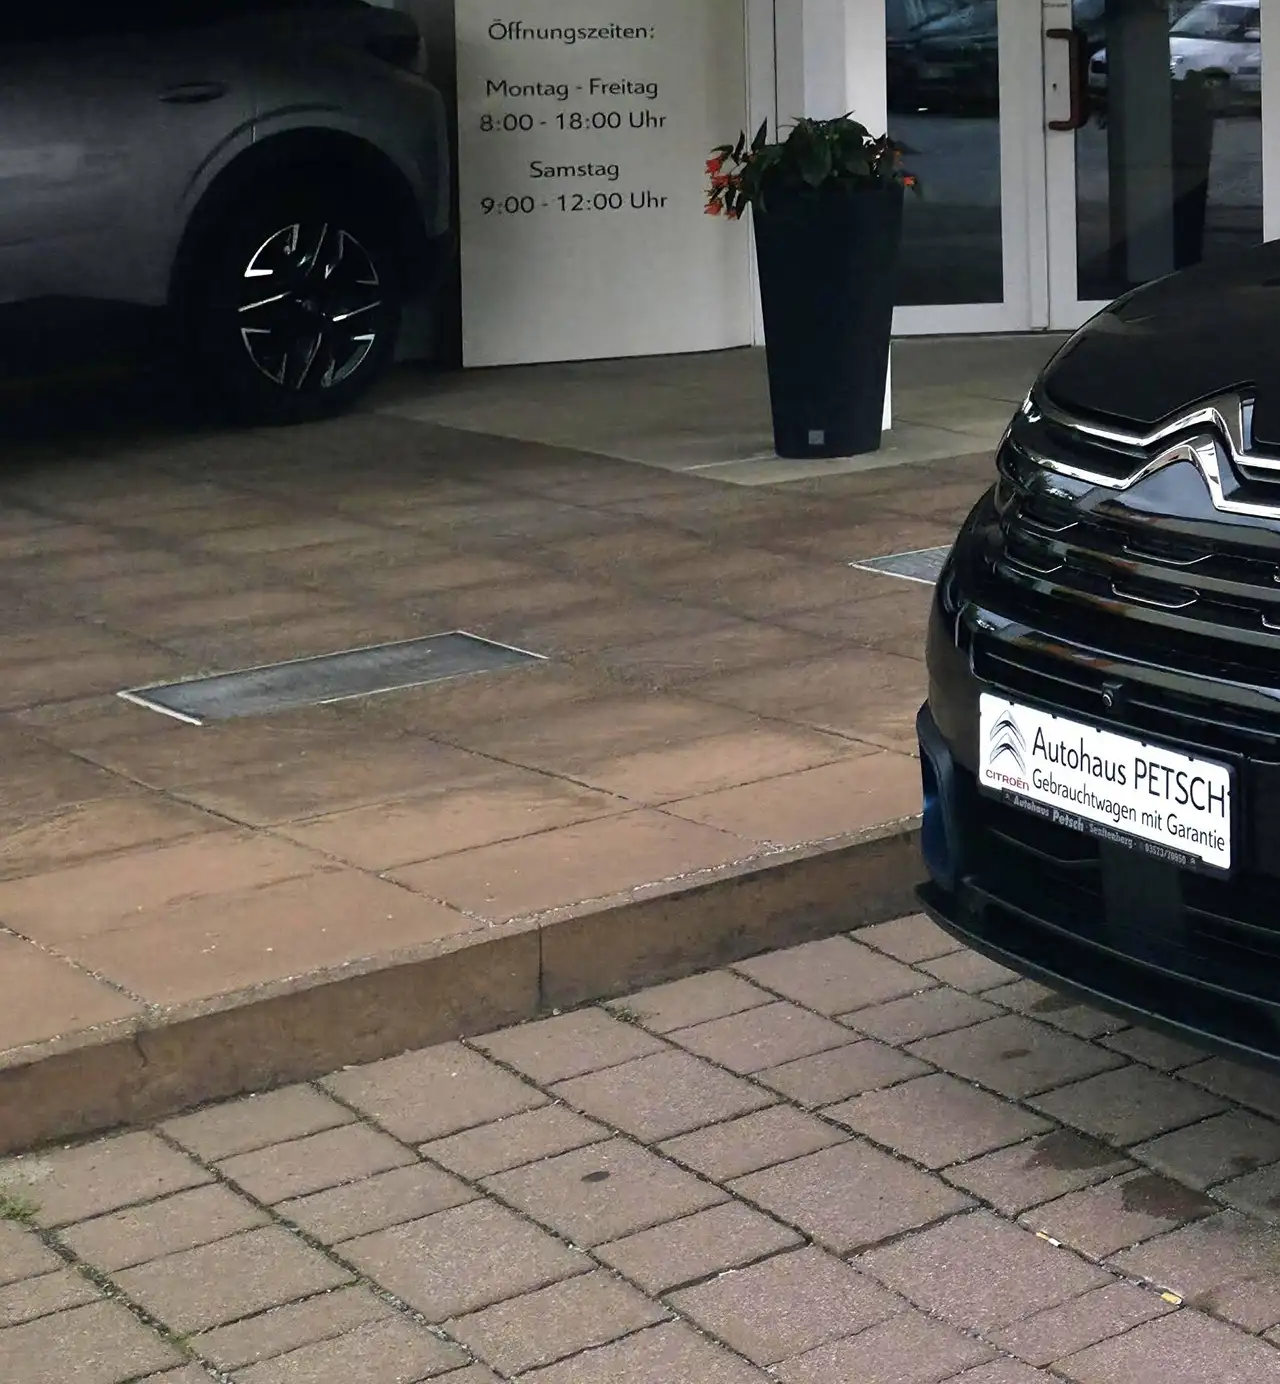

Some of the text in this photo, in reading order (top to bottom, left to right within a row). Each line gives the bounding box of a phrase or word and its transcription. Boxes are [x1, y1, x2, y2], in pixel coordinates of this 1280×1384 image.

[488, 18, 656, 44] Öffnungszeiten:
[486, 79, 569, 101] Montag
[589, 78, 659, 100] Freitag
[479, 113, 534, 132] 8:00
[556, 111, 621, 131] 18:00
[629, 110, 667, 129] Uhr
[529, 160, 620, 181] Samstag
[481, 195, 535, 214] 9:00
[557, 192, 623, 212] 12:00
[630, 190, 668, 210] Uhr
[985, 768, 1030, 791] CITROËN
[1032, 726, 1226, 818] Autohaus PETSCH
[1013, 795, 1050, 817] Autohaus
[1052, 809, 1085, 833] Petsch
[1032, 768, 1226, 852] Gebrauchtwagen mit Garantie
